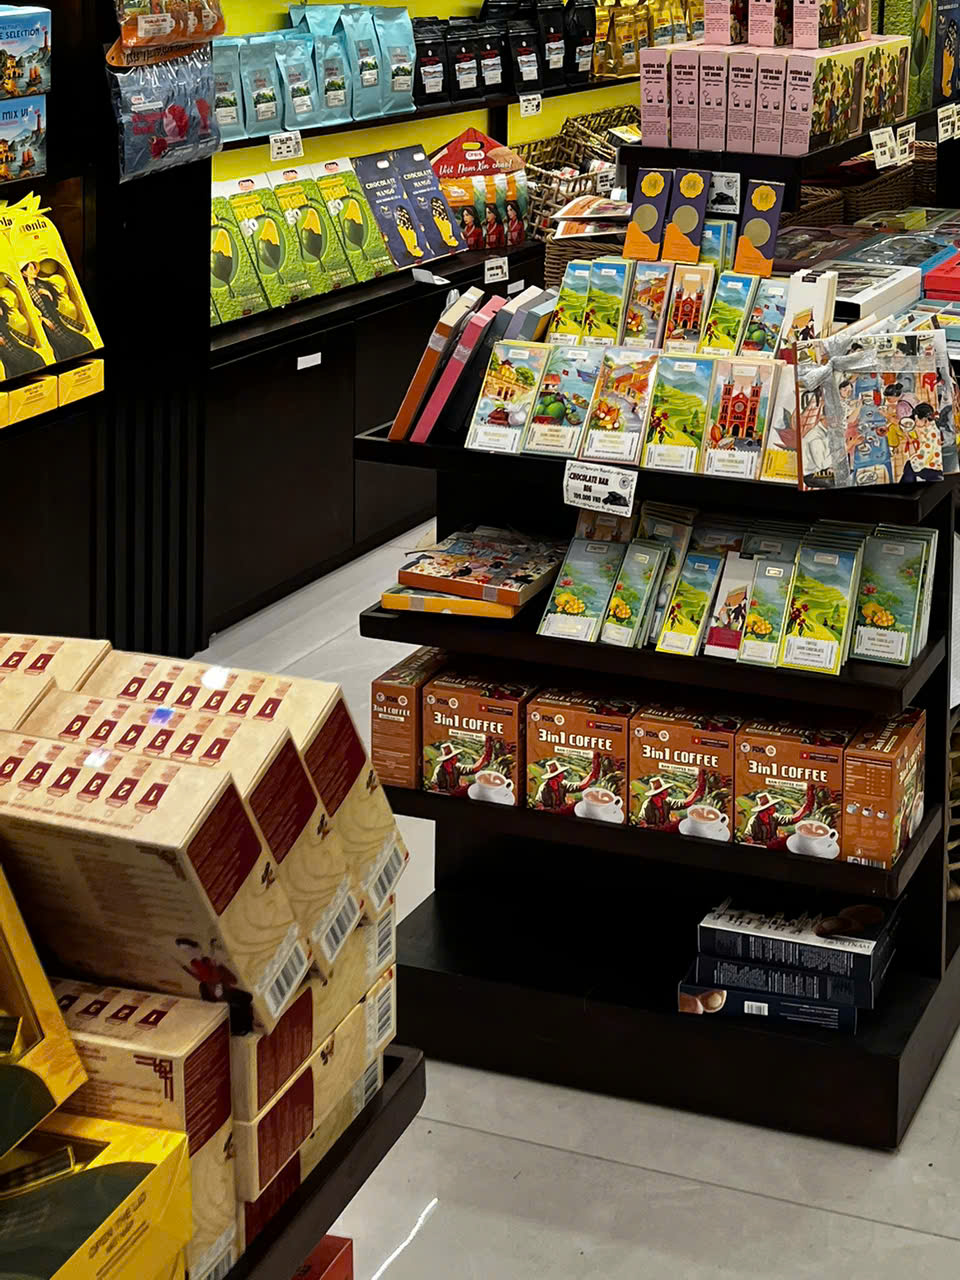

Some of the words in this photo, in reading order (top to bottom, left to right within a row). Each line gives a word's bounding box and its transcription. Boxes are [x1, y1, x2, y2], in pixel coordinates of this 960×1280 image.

[6, 28, 39, 39] SELECTION
[2, 110, 18, 120] MIX
[569, 472, 598, 484] CHOCOLATE
[598, 477, 609, 486] BAR
[388, 705, 411, 717] COFFEE
[434, 712, 459, 727] 3in1
[462, 718, 504, 734] COFFEE
[539, 729, 566, 745] 3in1
[569, 734, 613, 751] COFFEE
[642, 745, 670, 761] 3in1
[674, 751, 719, 768] COFFEE
[748, 760, 777, 776] 3in1
[781, 766, 828, 782] COFFEE
